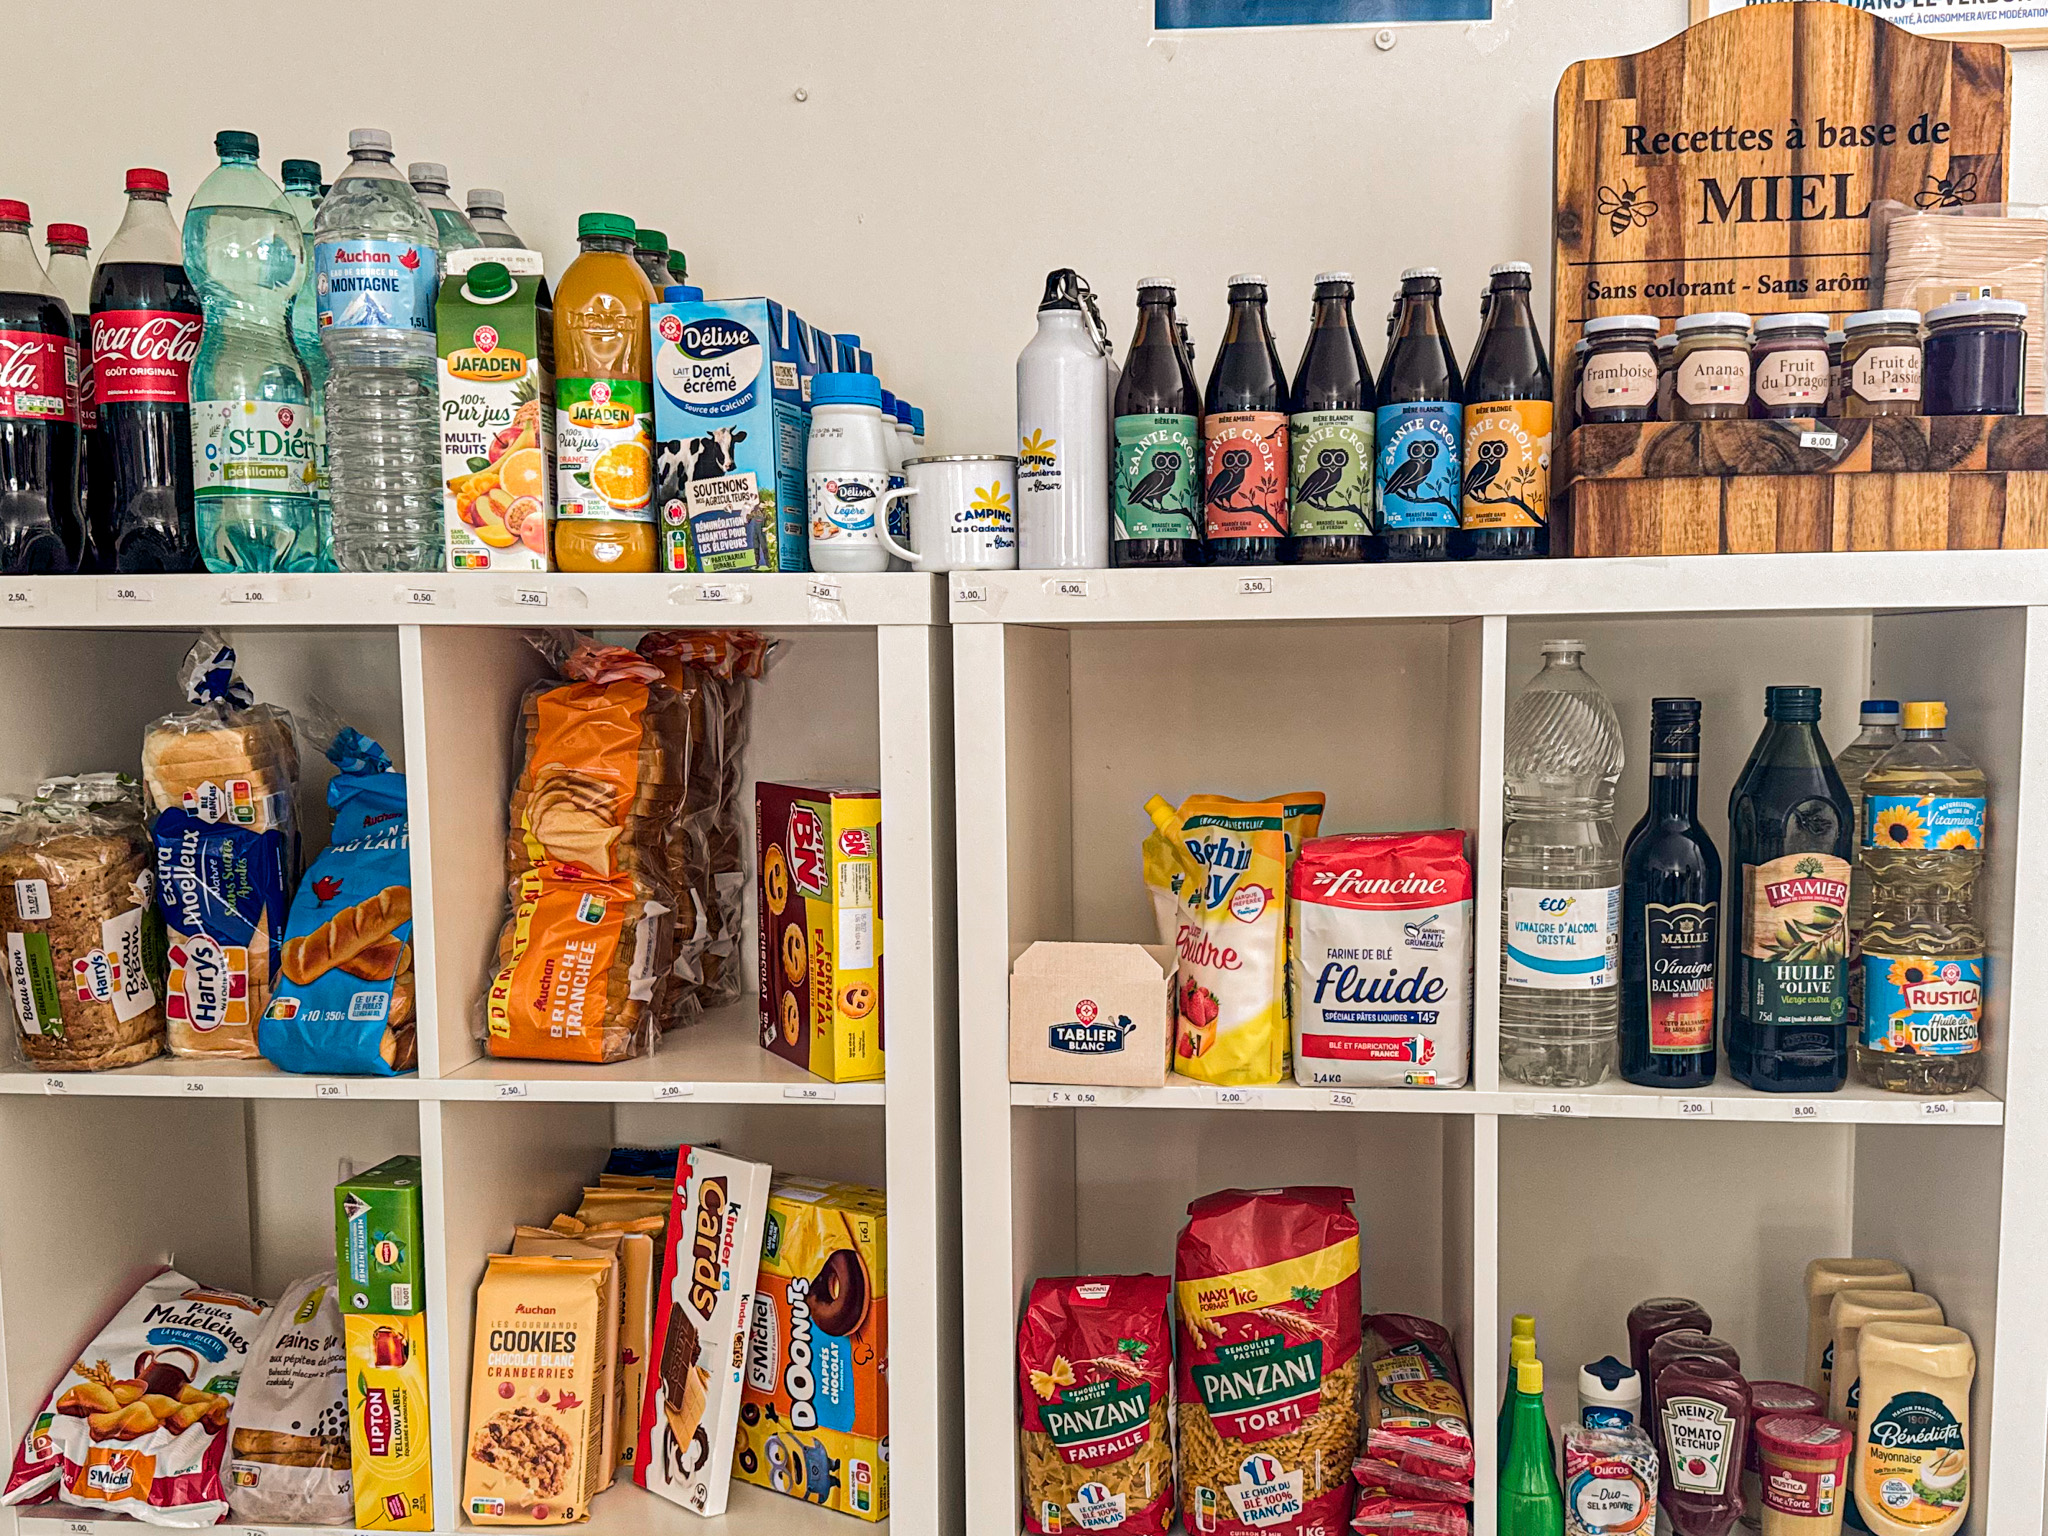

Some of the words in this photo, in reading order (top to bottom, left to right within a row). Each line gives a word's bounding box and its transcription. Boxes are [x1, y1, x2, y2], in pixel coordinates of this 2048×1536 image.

[1923, 12, 1976, 24] CONSOMMER
[1976, 11, 1997, 21] AVEC
[1998, 7, 2048, 20] MODÉRATION
[1621, 123, 1773, 156] Recettes
[1786, 119, 1805, 150] à
[1816, 117, 1896, 149] base
[1908, 113, 1951, 145] de
[1697, 171, 1870, 225] MIEL
[335, 248, 391, 264] Auchan
[331, 277, 400, 293] MONTAGNE
[1587, 280, 1637, 300] Sans
[1643, 277, 1736, 299] colorant
[1756, 275, 1808, 295] Sans
[409, 316, 427, 328] 1,5L
[92, 317, 201, 363] Coca-Cola
[683, 326, 750, 350] Délisse
[452, 355, 521, 373] JAFADEN
[672, 367, 690, 376] LAIT
[692, 363, 731, 378] Demi
[1694, 363, 1745, 377] Ananas
[1779, 358, 1815, 373] Fruit
[1869, 355, 1901, 370] Fruit
[1904, 354, 1919, 369] de
[105, 366, 128, 377] GOÛT
[129, 367, 178, 377] ORIGINAL
[1587, 364, 1653, 382] Framboise
[683, 376, 737, 394] écrémé
[460, 394, 486, 406] 100%
[573, 405, 629, 422] JAFADEN
[1475, 406, 1490, 414] BIÈRE
[1490, 405, 1512, 413] BLONDE
[445, 433, 487, 444] MULTI-
[565, 429, 583, 437] 100%
[1385, 417, 1424, 466] SAINTE
[1429, 419, 1458, 464] CROIX
[445, 443, 487, 455] FRUITS
[559, 456, 589, 464] ORANGE
[228, 465, 287, 478] pétillante
[693, 478, 749, 499] SOUTENONS
[839, 484, 873, 498] Délisse
[954, 508, 1011, 523] CAMPING
[531, 559, 542, 570] 1L
[209, 785, 218, 821] FRANÇAIS
[157, 845, 177, 907] Extra
[174, 828, 201, 927] Moelleux
[1323, 868, 1445, 897] francine
[1767, 882, 1846, 901] TRAMIER
[1515, 921, 1556, 934] VINAIGRE
[1558, 921, 1598, 934] D'ALCOOL
[1404, 938, 1445, 949] GRUMEAUX
[1421, 933, 1445, 941] ANTI-
[1536, 934, 1577, 946] CRISTAL
[1661, 933, 1709, 944] MAILLE
[131, 925, 142, 979] Bon
[1327, 948, 1360, 960] FARINE
[1361, 948, 1374, 960] DE
[1376, 946, 1393, 961] BLÉ
[14, 949, 25, 977] Bon
[122, 931, 140, 1001] Beau
[1654, 958, 1713, 979] Vinaigre
[91, 955, 109, 997] Harrys
[1776, 964, 1835, 982] HUILE
[19, 977, 27, 987] &
[140, 980, 149, 991] &
[191, 946, 219, 1022] Harrys
[533, 958, 556, 1012] Auchan
[550, 939, 579, 1038] BRIOCHE
[565, 940, 597, 1039] TRANCHÉE
[814, 928, 827, 1039] FAMILIAL
[825, 950, 834, 1024] FORMAT
[1313, 961, 1449, 1005] fluide
[1652, 977, 1714, 993] BALSAMIQUE
[1779, 982, 1831, 994] d'OLIVE
[23, 986, 34, 1022] Beau
[1780, 996, 1806, 1006] Vierge
[1807, 996, 1831, 1005] extra
[1912, 988, 1979, 1006] RUSTICA
[1324, 1011, 1355, 1022] SPÉCIALE
[1356, 1010, 1377, 1022] PÂTES
[1377, 1012, 1408, 1022] LIQUIDES
[1417, 1011, 1436, 1024] T45
[1758, 1011, 1773, 1022] 75cl
[1930, 1014, 1955, 1027] Huile
[1956, 1016, 1968, 1027] de
[1057, 1028, 1117, 1042] TABLIER
[1912, 1025, 1978, 1043] TOURNESOL
[1069, 1041, 1105, 1051] BLANC
[1329, 1040, 1342, 1050] BLÉ
[1343, 1041, 1353, 1050] ET
[1354, 1041, 1400, 1051] FABRICATION
[1370, 1050, 1400, 1059] FRANCE
[1052, 1093, 1059, 1102] 5
[357, 1218, 365, 1250] MENTHE
[689, 1179, 726, 1314] Cards
[359, 1250, 367, 1283] INTENSE
[402, 1287, 410, 1306] 100%
[1198, 1287, 1228, 1303] MAXI
[186, 1302, 234, 1321] Petites
[515, 1303, 557, 1315] Auchan
[1200, 1300, 1230, 1313] FORMAT
[142, 1303, 251, 1355] Madeleines
[491, 1320, 509, 1329] LES
[515, 1320, 578, 1330] GOURMANDS
[488, 1329, 577, 1354] COOKIES
[1224, 1338, 1276, 1356] SEMOULIER
[488, 1352, 539, 1367] CHOCOLAT
[540, 1354, 575, 1367] BLANC
[1233, 1347, 1271, 1361] PASTIER
[487, 1367, 575, 1379] CRANBERRIES
[821, 1347, 830, 1396] NAPPÉS
[829, 1341, 841, 1406] CHOCOLAT
[1203, 1354, 1317, 1404] PANZANI
[393, 1386, 402, 1420] LABEL
[1048, 1394, 1146, 1437] PANZANI
[1234, 1404, 1302, 1434] TORTI
[1677, 1405, 1716, 1421] HEINZ
[369, 1391, 386, 1454] LIPTON
[394, 1420, 404, 1460] YELLOW
[1672, 1423, 1722, 1441] TOMATO
[1872, 1421, 1958, 1449] Bénédicta
[1068, 1431, 1144, 1462] FARFALLE
[1675, 1436, 1720, 1452] KETCHUP
[1870, 1447, 1922, 1464] Mayonnaise
[1593, 1464, 1630, 1476] Ducros
[1240, 1490, 1252, 1500] LE
[1251, 1485, 1277, 1499] CHOIX
[1278, 1482, 1291, 1492] DU
[1599, 1487, 1621, 1500] Duo
[1772, 1478, 1805, 1492] RUSTICA
[412, 1497, 420, 1510] 30
[1242, 1499, 1301, 1523] FRANÇAIS
[1586, 1500, 1601, 1511] SEL
[1602, 1502, 1608, 1510] &
[1608, 1502, 1634, 1512] POIVRE
[1082, 1510, 1096, 1519] BLÉ
[1096, 1507, 1119, 1517] 100%
[1082, 1511, 1124, 1528] FRANÇAIS
